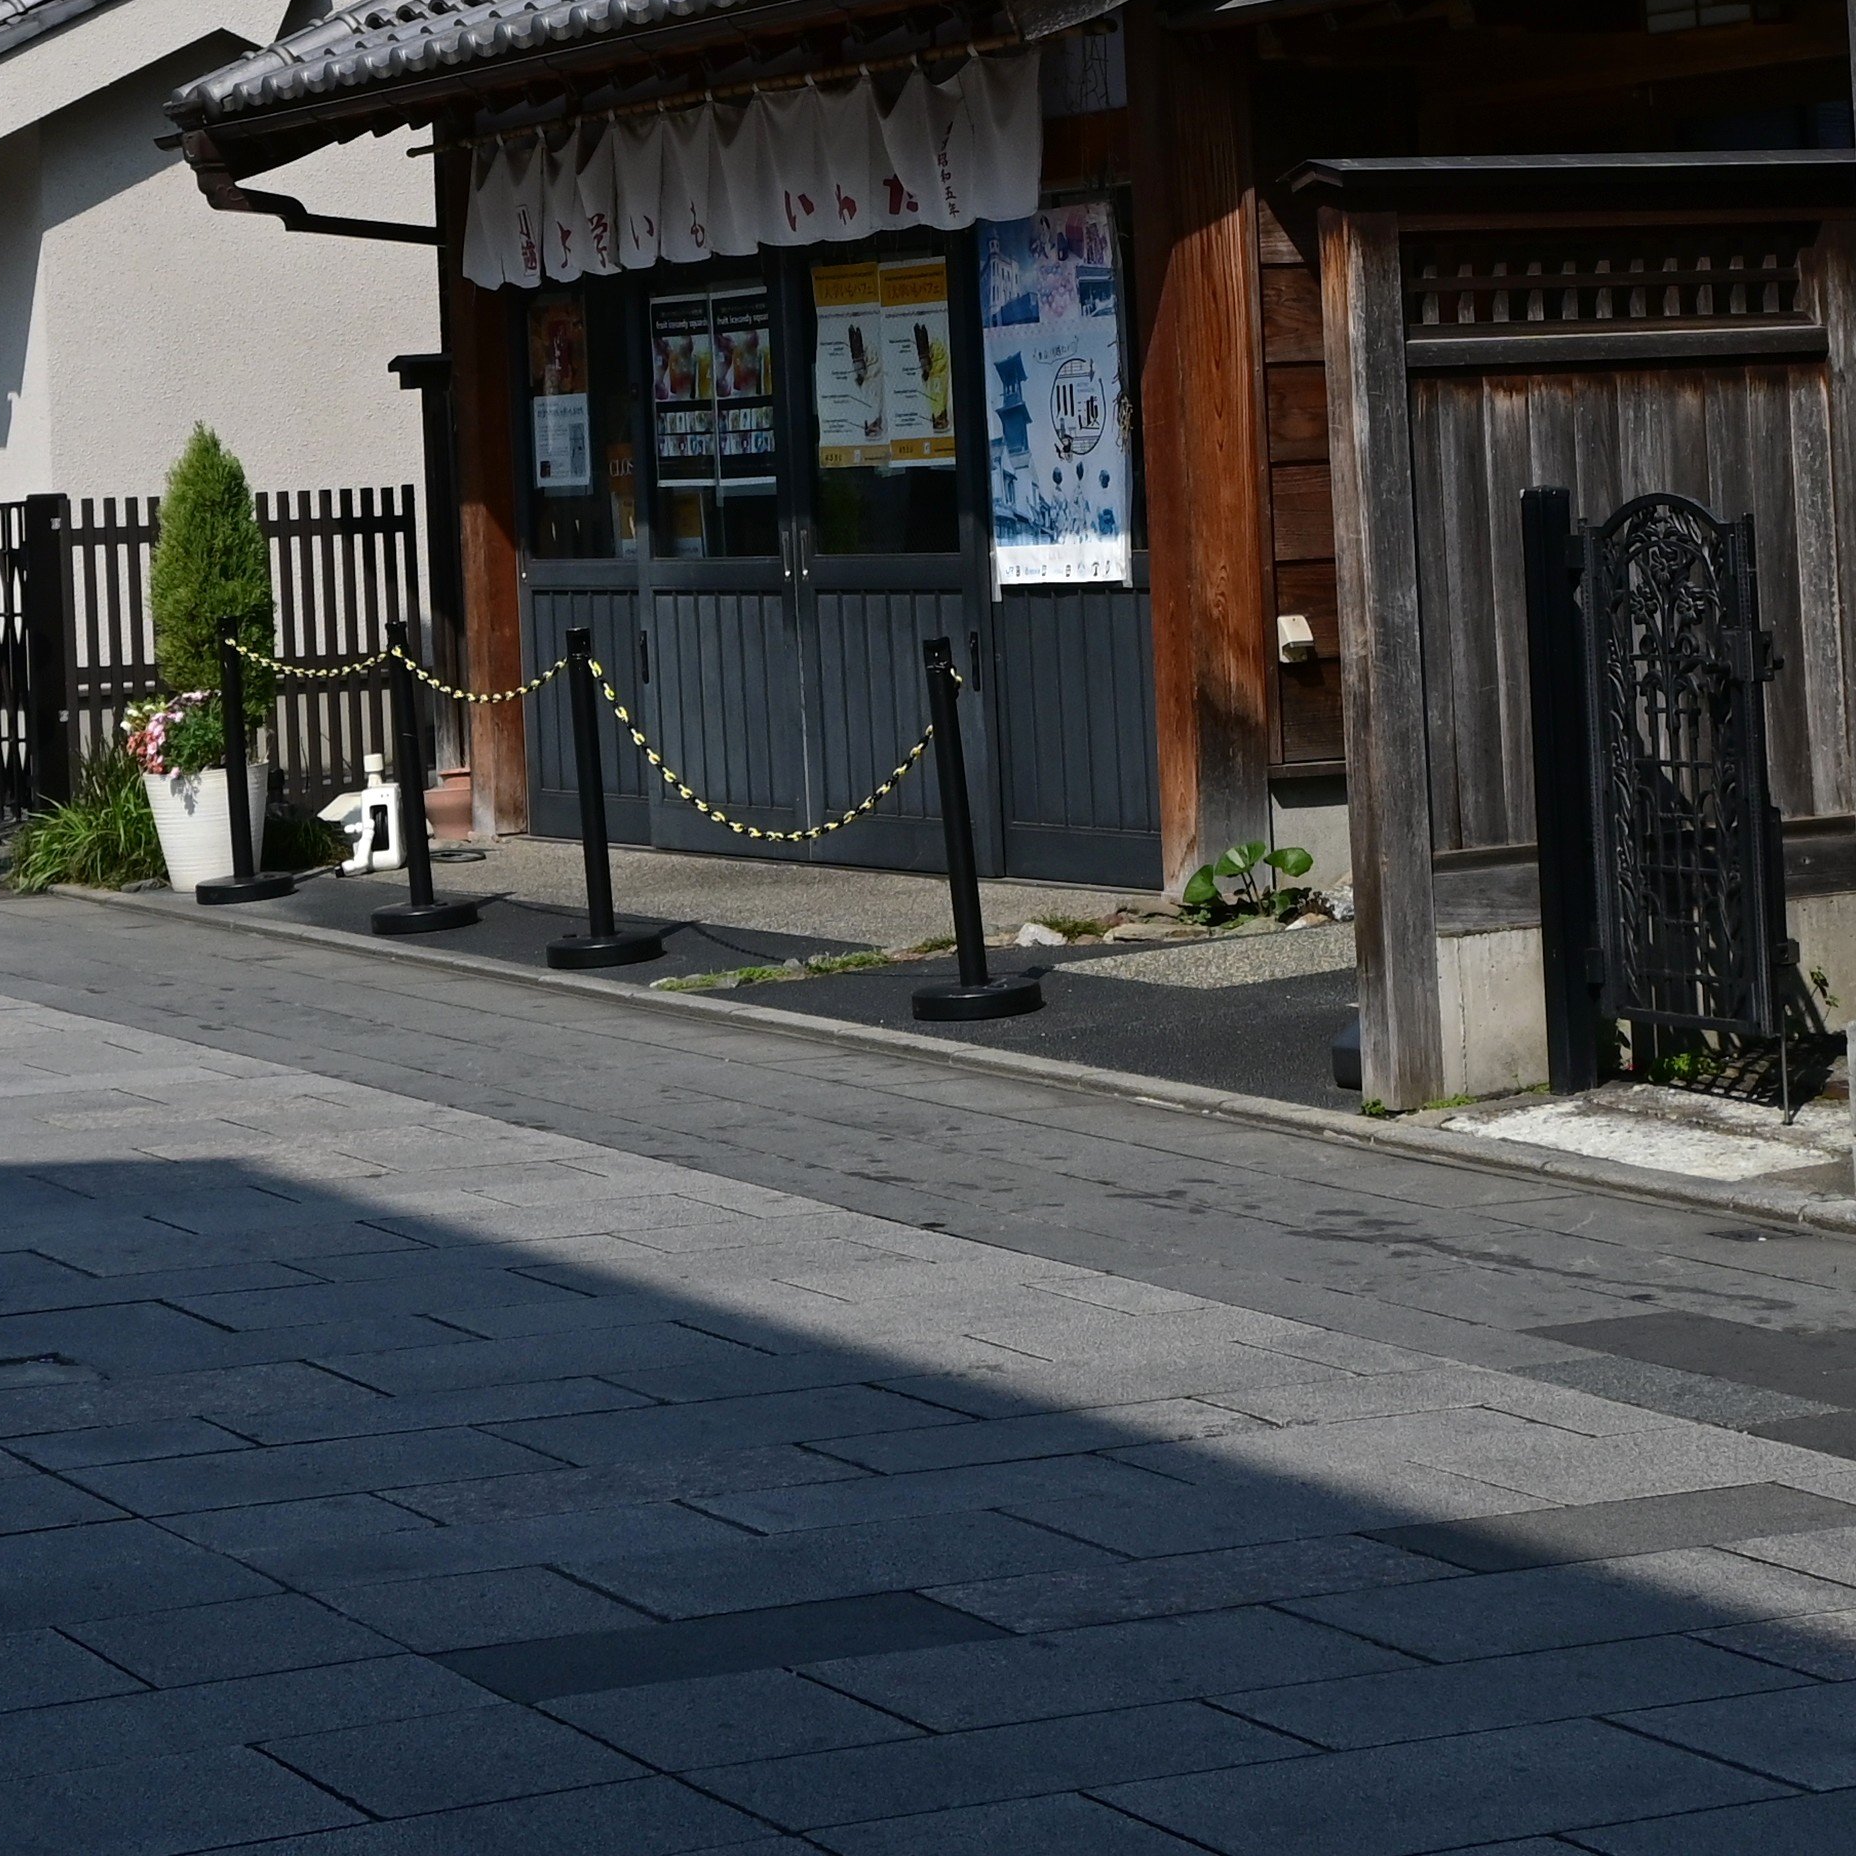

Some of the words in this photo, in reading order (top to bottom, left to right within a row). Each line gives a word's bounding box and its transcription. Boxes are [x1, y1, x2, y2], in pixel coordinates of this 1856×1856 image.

[937, 121, 960, 219] 昭和五年
[784, 173, 919, 232] いわた
[1056, 383, 1101, 431] 川越
